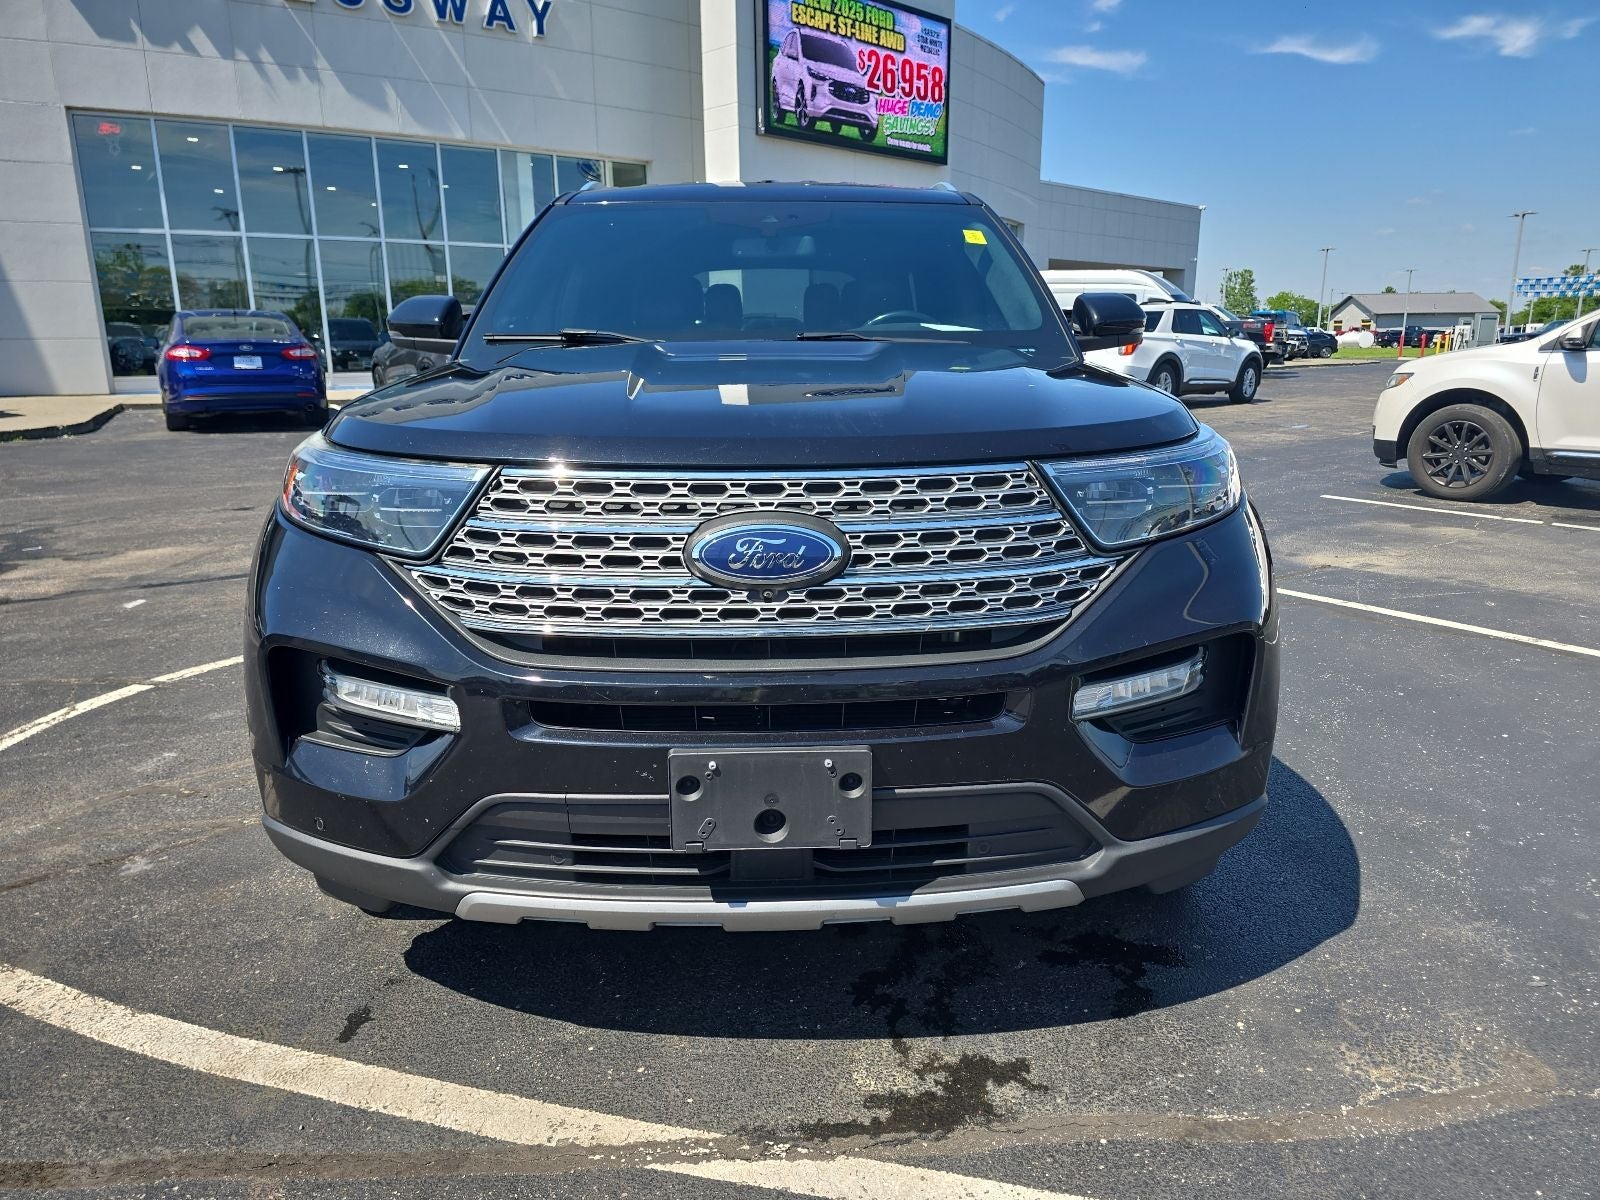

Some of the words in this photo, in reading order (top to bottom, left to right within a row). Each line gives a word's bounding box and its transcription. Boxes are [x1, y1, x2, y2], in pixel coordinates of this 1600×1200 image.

[791, 3, 837, 33] ESCAPE
[837, 16, 879, 45] ST-LINE
[879, 29, 905, 52] AWD
[834, 0, 864, 21] 2025
[865, 5, 894, 31] FORD
[877, 97, 909, 116] HUGE
[910, 100, 943, 119] DEMO
[727, 537, 807, 570] Ford
